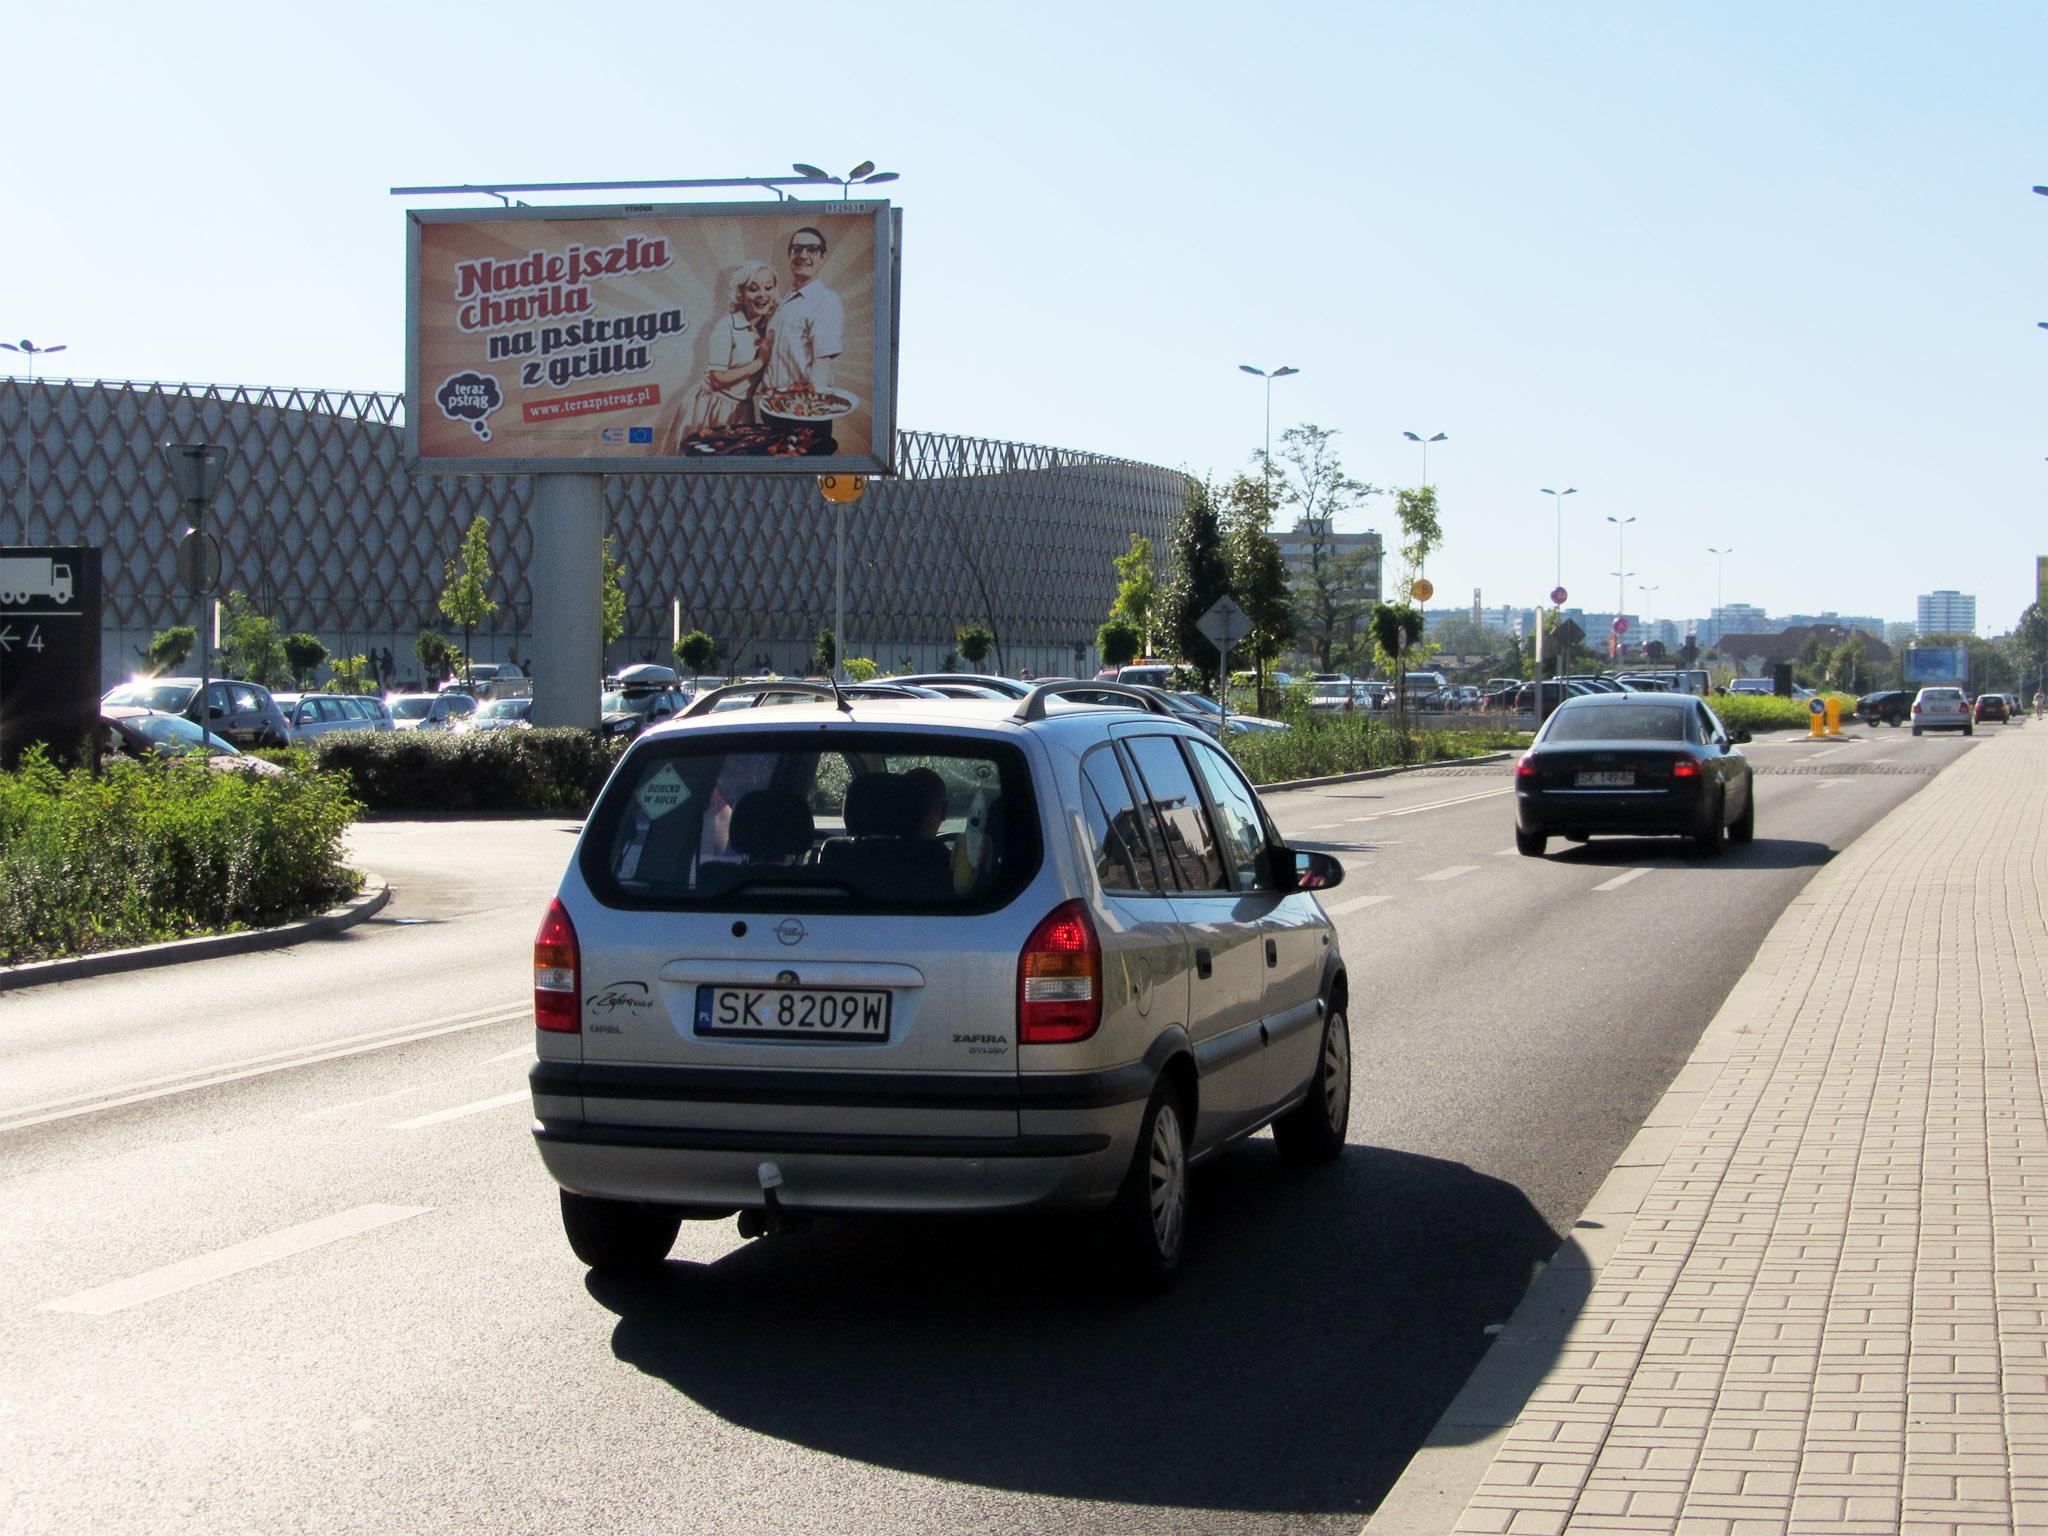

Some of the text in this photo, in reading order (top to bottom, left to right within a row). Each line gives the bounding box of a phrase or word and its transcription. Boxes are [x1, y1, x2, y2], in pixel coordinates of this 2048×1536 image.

[460, 285, 592, 330] chwila
[489, 330, 537, 359] na
[522, 345, 652, 387] z grilla
[455, 384, 486, 396] teraz
[530, 387, 651, 416] www.terazpstrag.pl
[26, 624, 45, 653] 4
[699, 1012, 710, 1022] PL
[718, 992, 882, 1030] SK 8209W
[952, 1034, 1008, 1044] ZAFIRA
